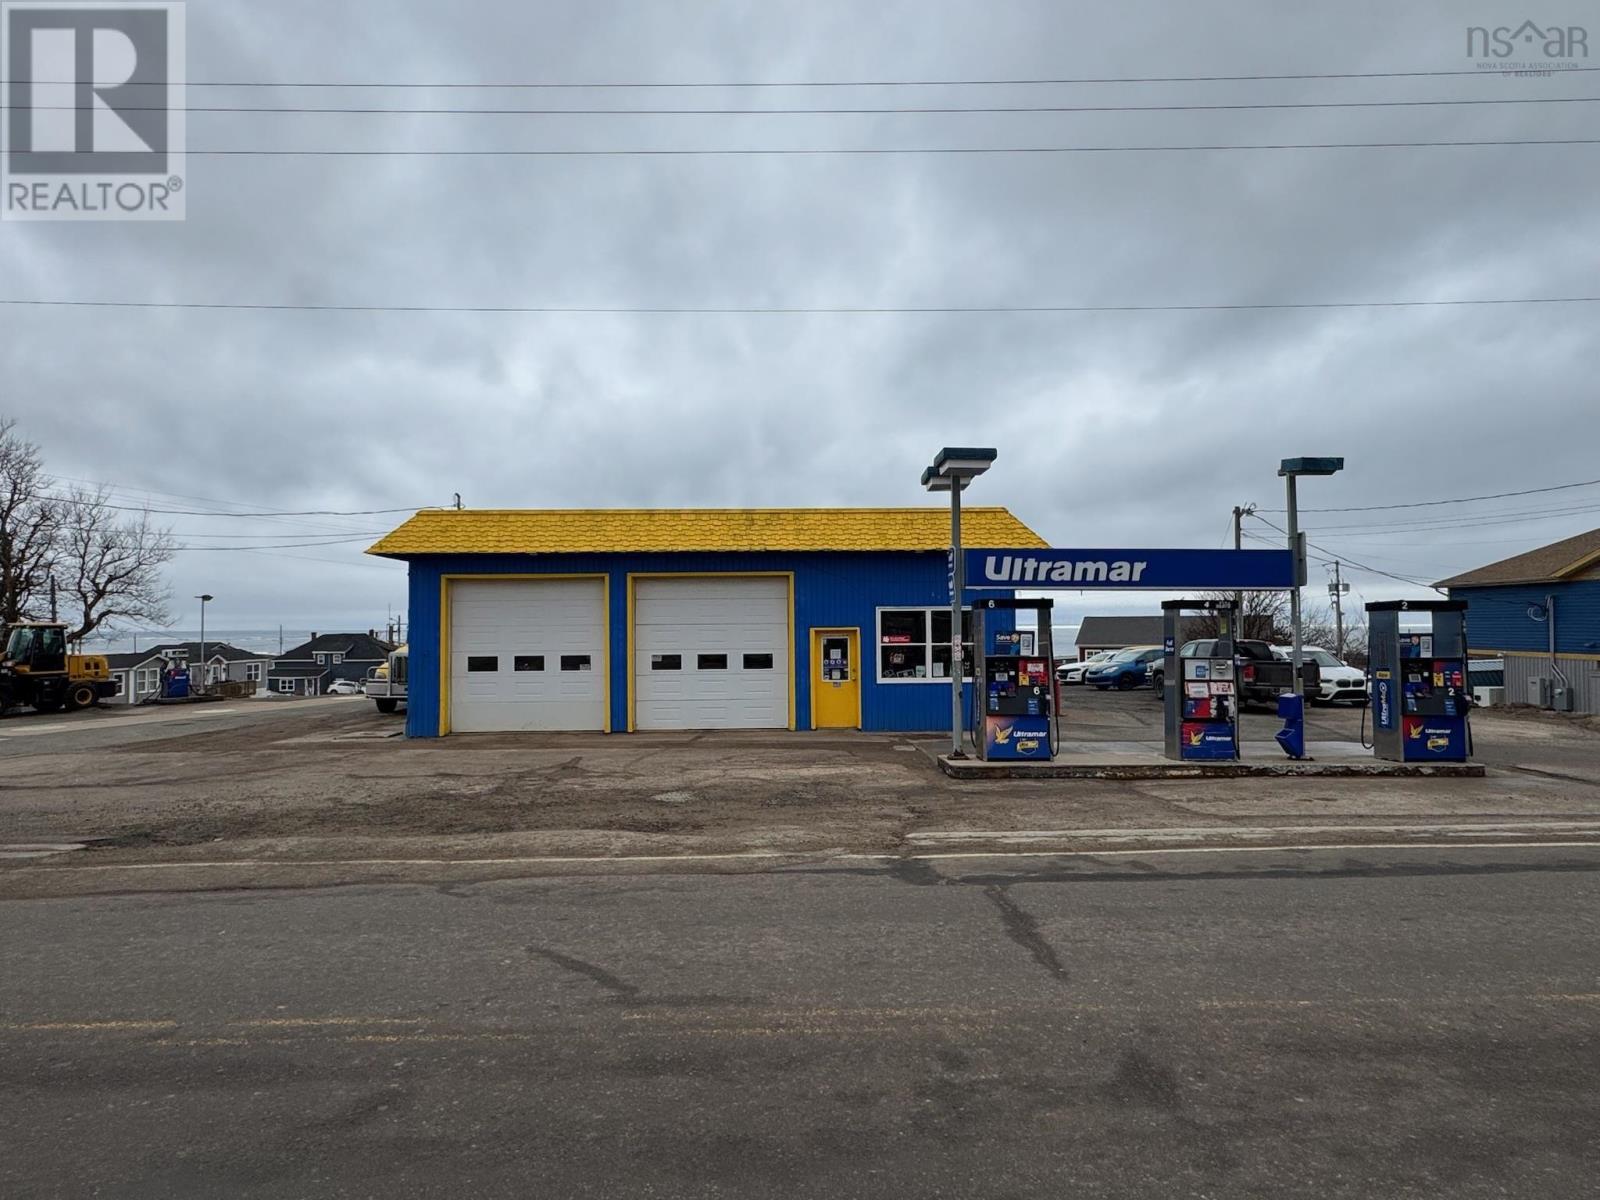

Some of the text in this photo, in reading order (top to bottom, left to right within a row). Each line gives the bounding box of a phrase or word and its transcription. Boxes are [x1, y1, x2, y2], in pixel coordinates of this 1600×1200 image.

[984, 556, 1147, 582] Ultramar
[988, 600, 995, 608] 6
[1401, 601, 1408, 610] 2
[1033, 686, 1040, 695] 6
[1448, 688, 1455, 696] 2
[1013, 730, 1047, 738] Ultramar
